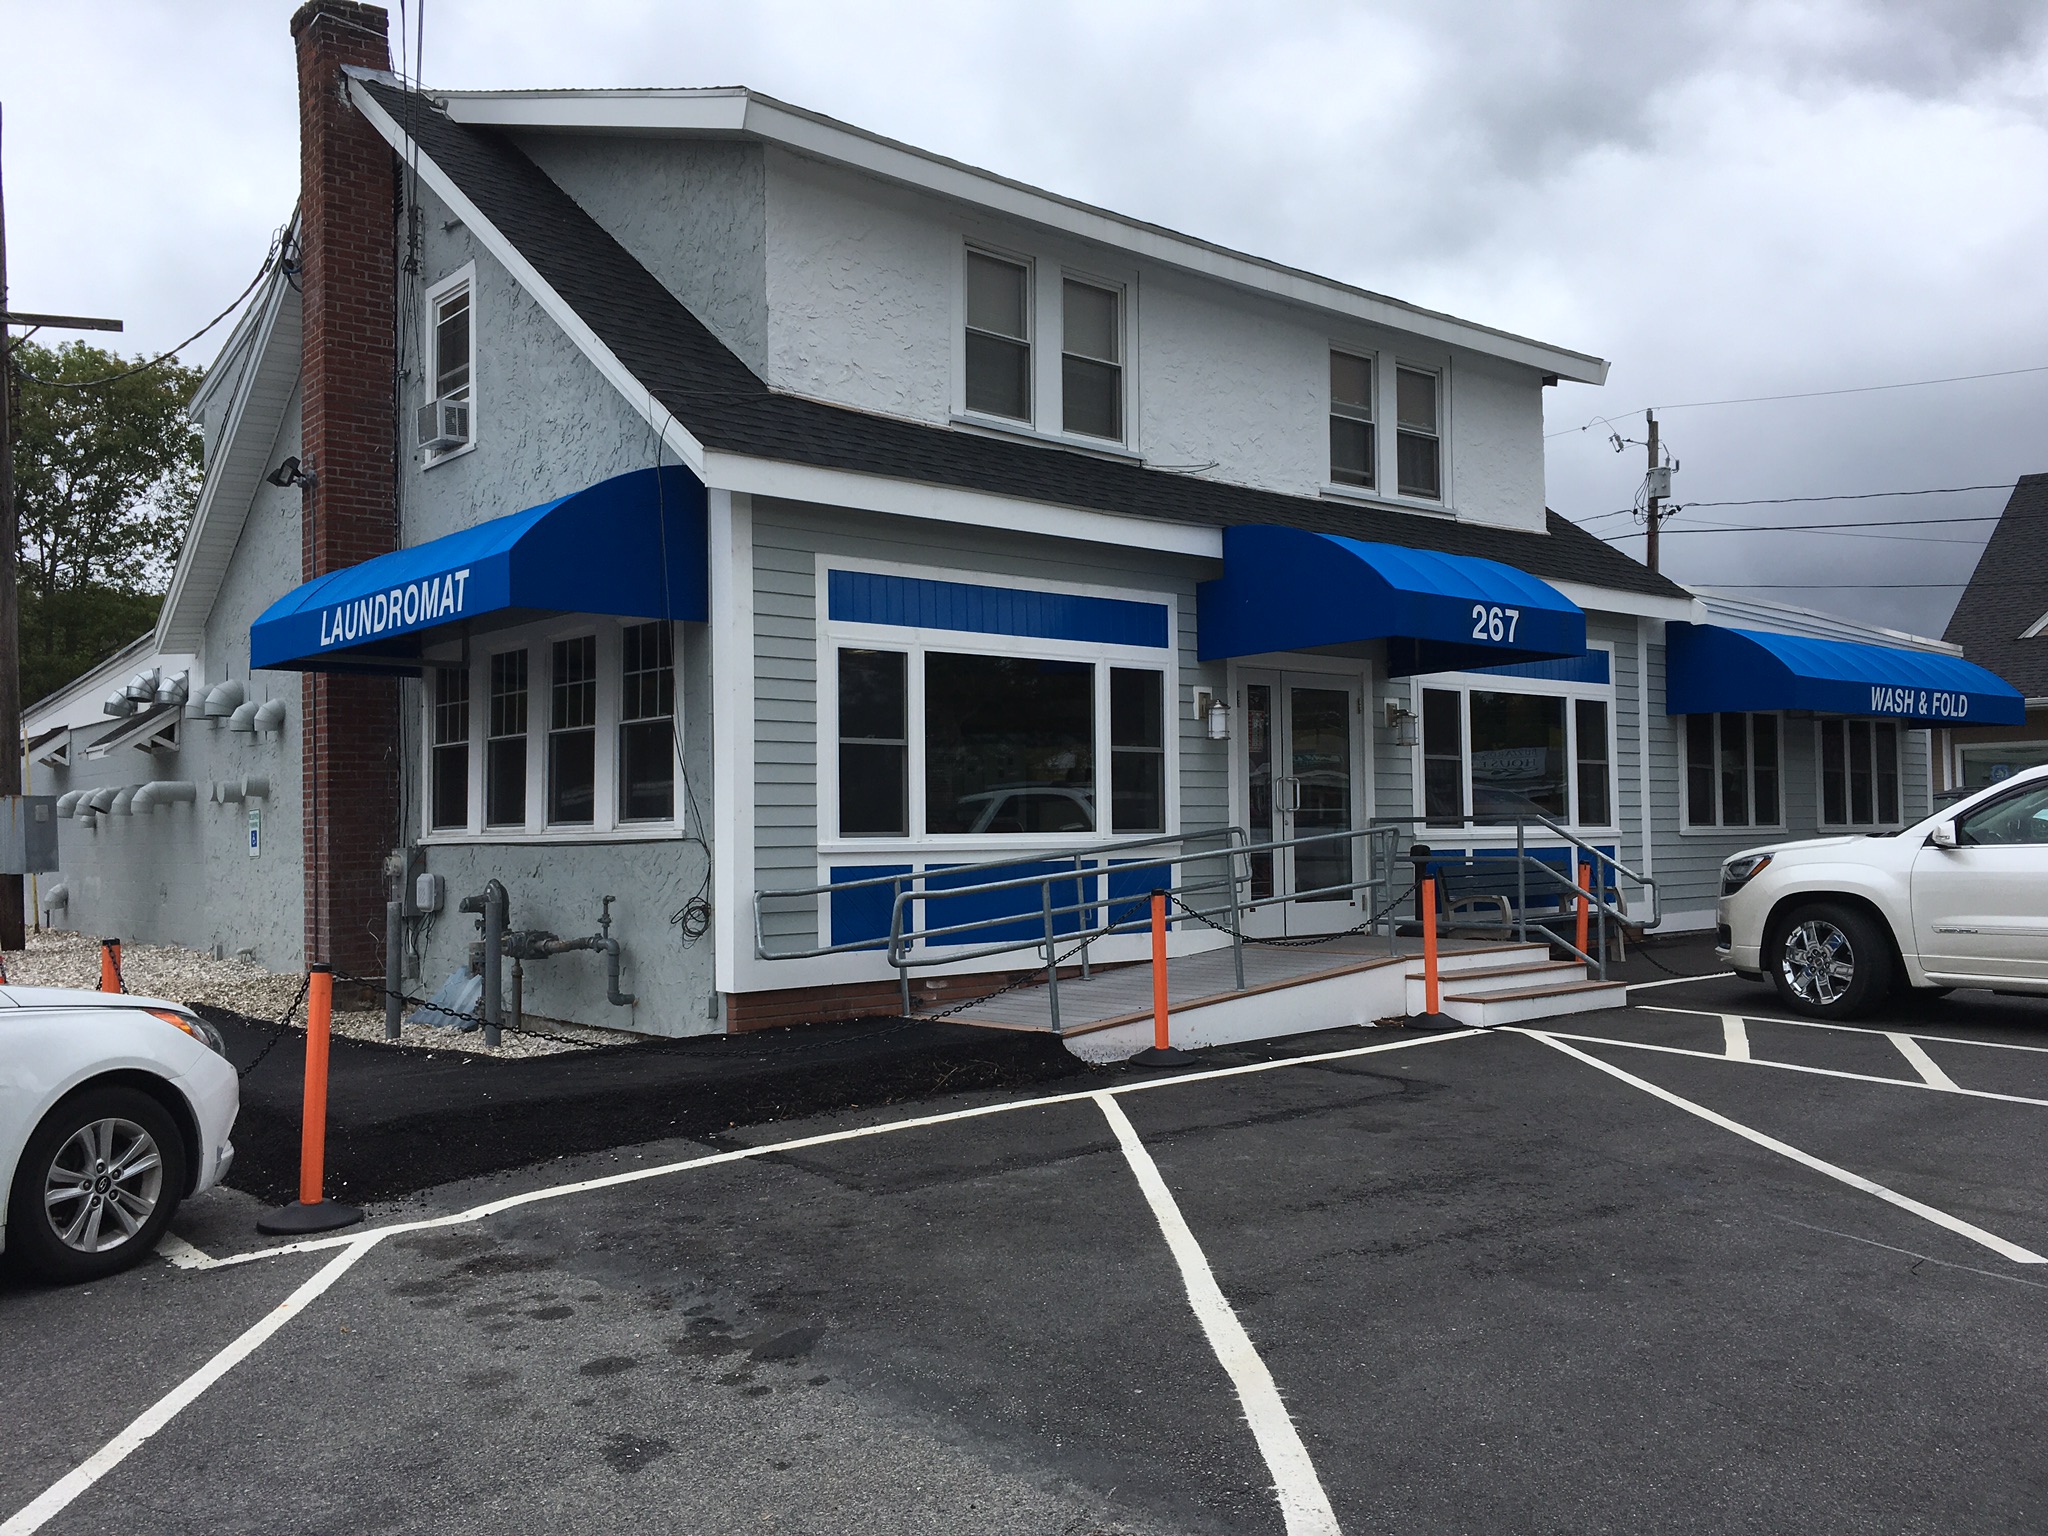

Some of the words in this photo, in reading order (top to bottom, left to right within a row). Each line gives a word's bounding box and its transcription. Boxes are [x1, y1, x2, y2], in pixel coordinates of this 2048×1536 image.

[320, 568, 470, 647] LAUNDROMAT
[1472, 604, 1519, 643] 267
[1871, 686, 1915, 714] WASH
[1918, 691, 1928, 715] &
[1932, 692, 1968, 717] FOLD
